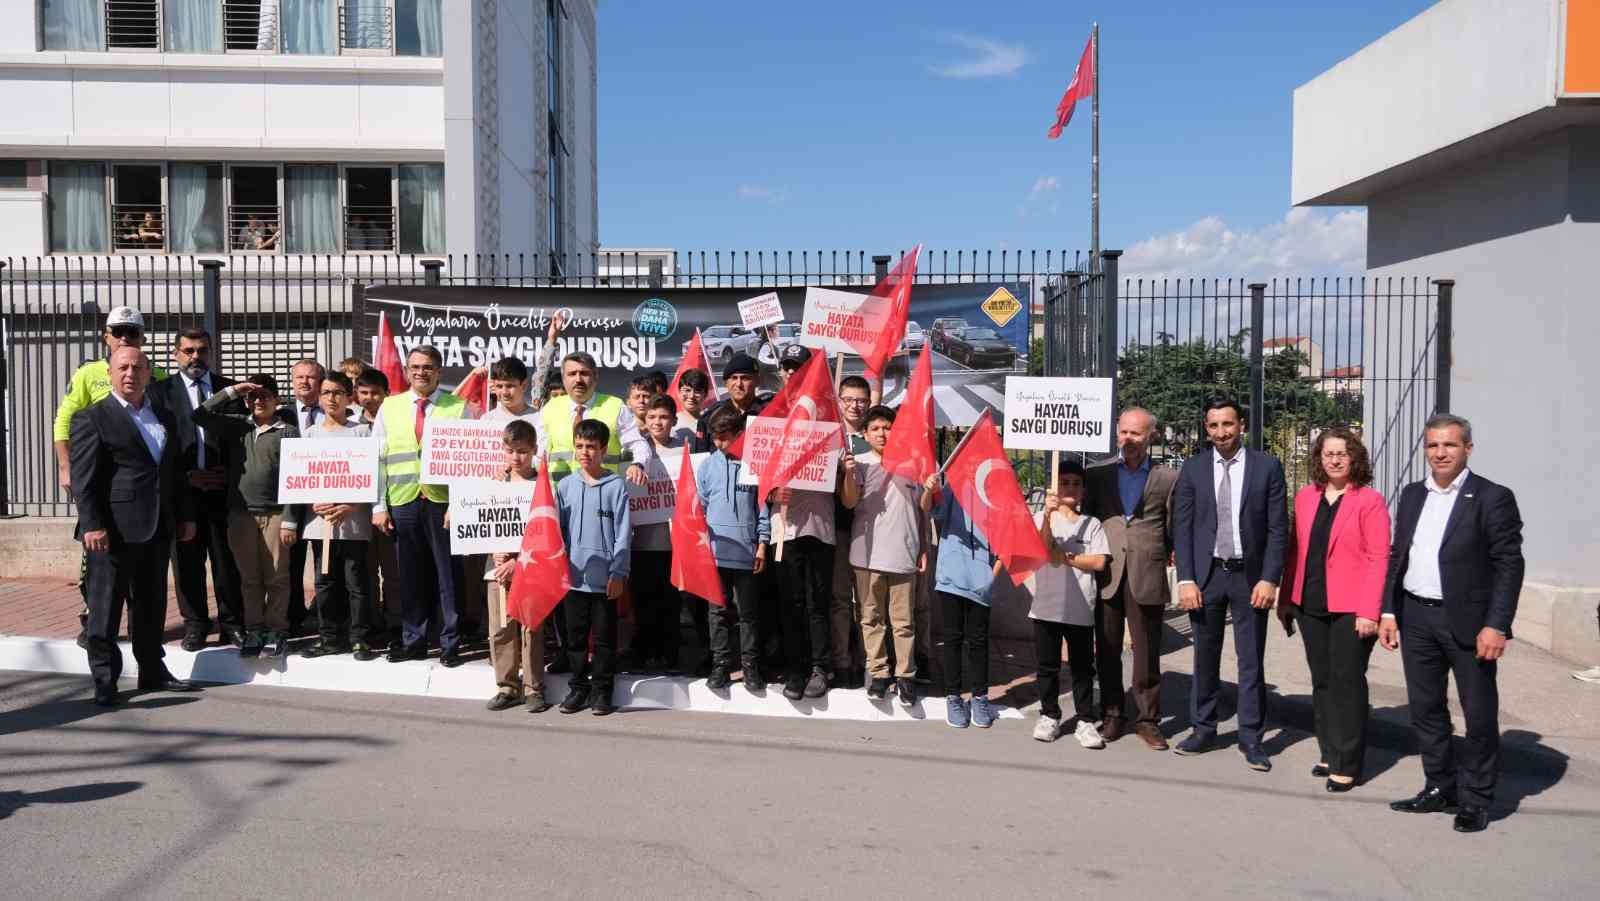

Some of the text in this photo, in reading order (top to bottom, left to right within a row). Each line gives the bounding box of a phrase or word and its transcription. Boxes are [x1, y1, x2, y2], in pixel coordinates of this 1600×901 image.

[401, 303, 624, 335] Yayalara Öncelik Duruşu
[641, 314, 667, 325] DAHA
[827, 311, 865, 328] HAYATA
[807, 322, 837, 338] SAYGI
[1034, 403, 1080, 419] HAYATA
[1011, 418, 1103, 437] SAYGI DURUŞU
[431, 438, 504, 451] 29 EYLÜL'D
[752, 437, 768, 449] 29
[431, 450, 450, 460] YAYA
[308, 461, 350, 474] HAYATA
[286, 474, 371, 489] SAYGI DURUŞU
[629, 496, 660, 512] SAYGI
[478, 507, 521, 522] HAYATA
[457, 523, 491, 539] SAYGI
